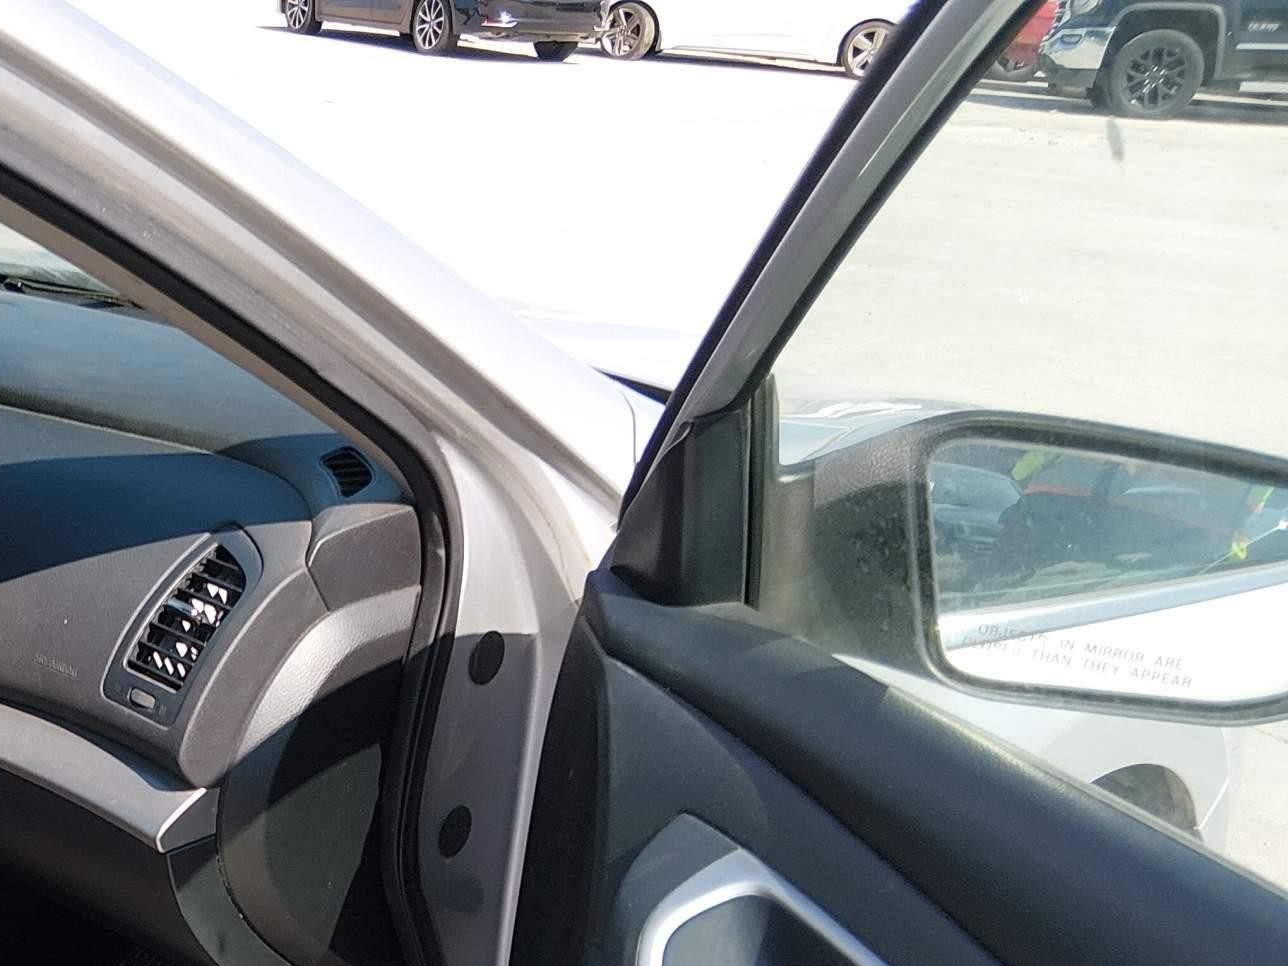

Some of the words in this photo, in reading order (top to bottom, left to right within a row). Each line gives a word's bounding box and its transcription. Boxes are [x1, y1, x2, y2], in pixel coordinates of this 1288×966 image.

[1031, 649, 1073, 667] THAN
[1082, 658, 1121, 676] THEY
[1129, 666, 1194, 689] APPEAR
[1059, 638, 1076, 651] IN
[1083, 642, 1145, 663] MIRROR
[1153, 655, 1185, 671] ARE
